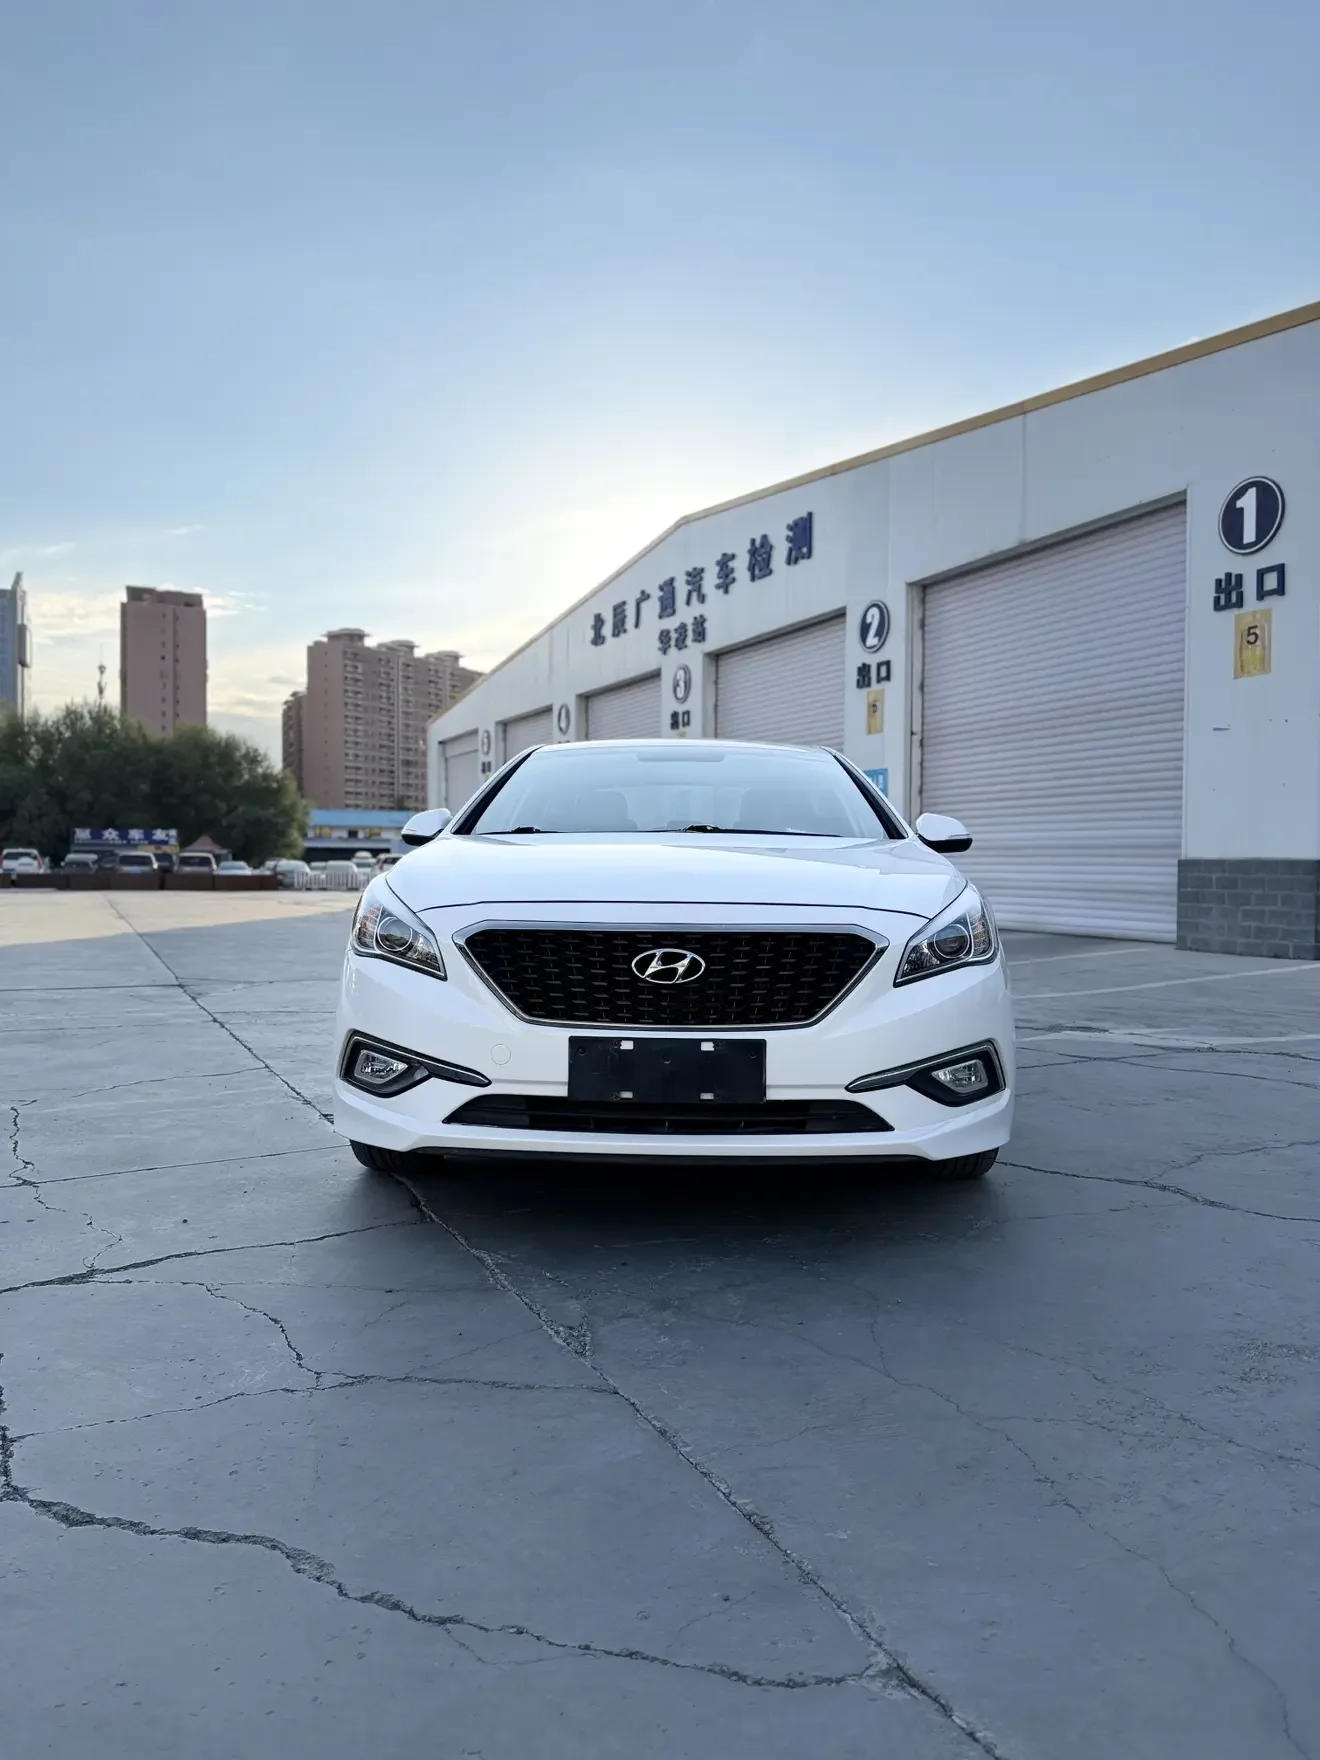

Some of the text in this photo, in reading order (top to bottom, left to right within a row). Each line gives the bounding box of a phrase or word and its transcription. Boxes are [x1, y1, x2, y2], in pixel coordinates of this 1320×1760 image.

[1235, 486, 1257, 544] 1
[590, 511, 816, 647] 北辰广通汽车检测
[1213, 562, 1286, 612] 出口
[864, 607, 881, 647] 2
[1246, 625, 1259, 645] 5
[675, 668, 685, 698] 3
[856, 659, 891, 689] 出口
[670, 709, 690, 730] 出口
